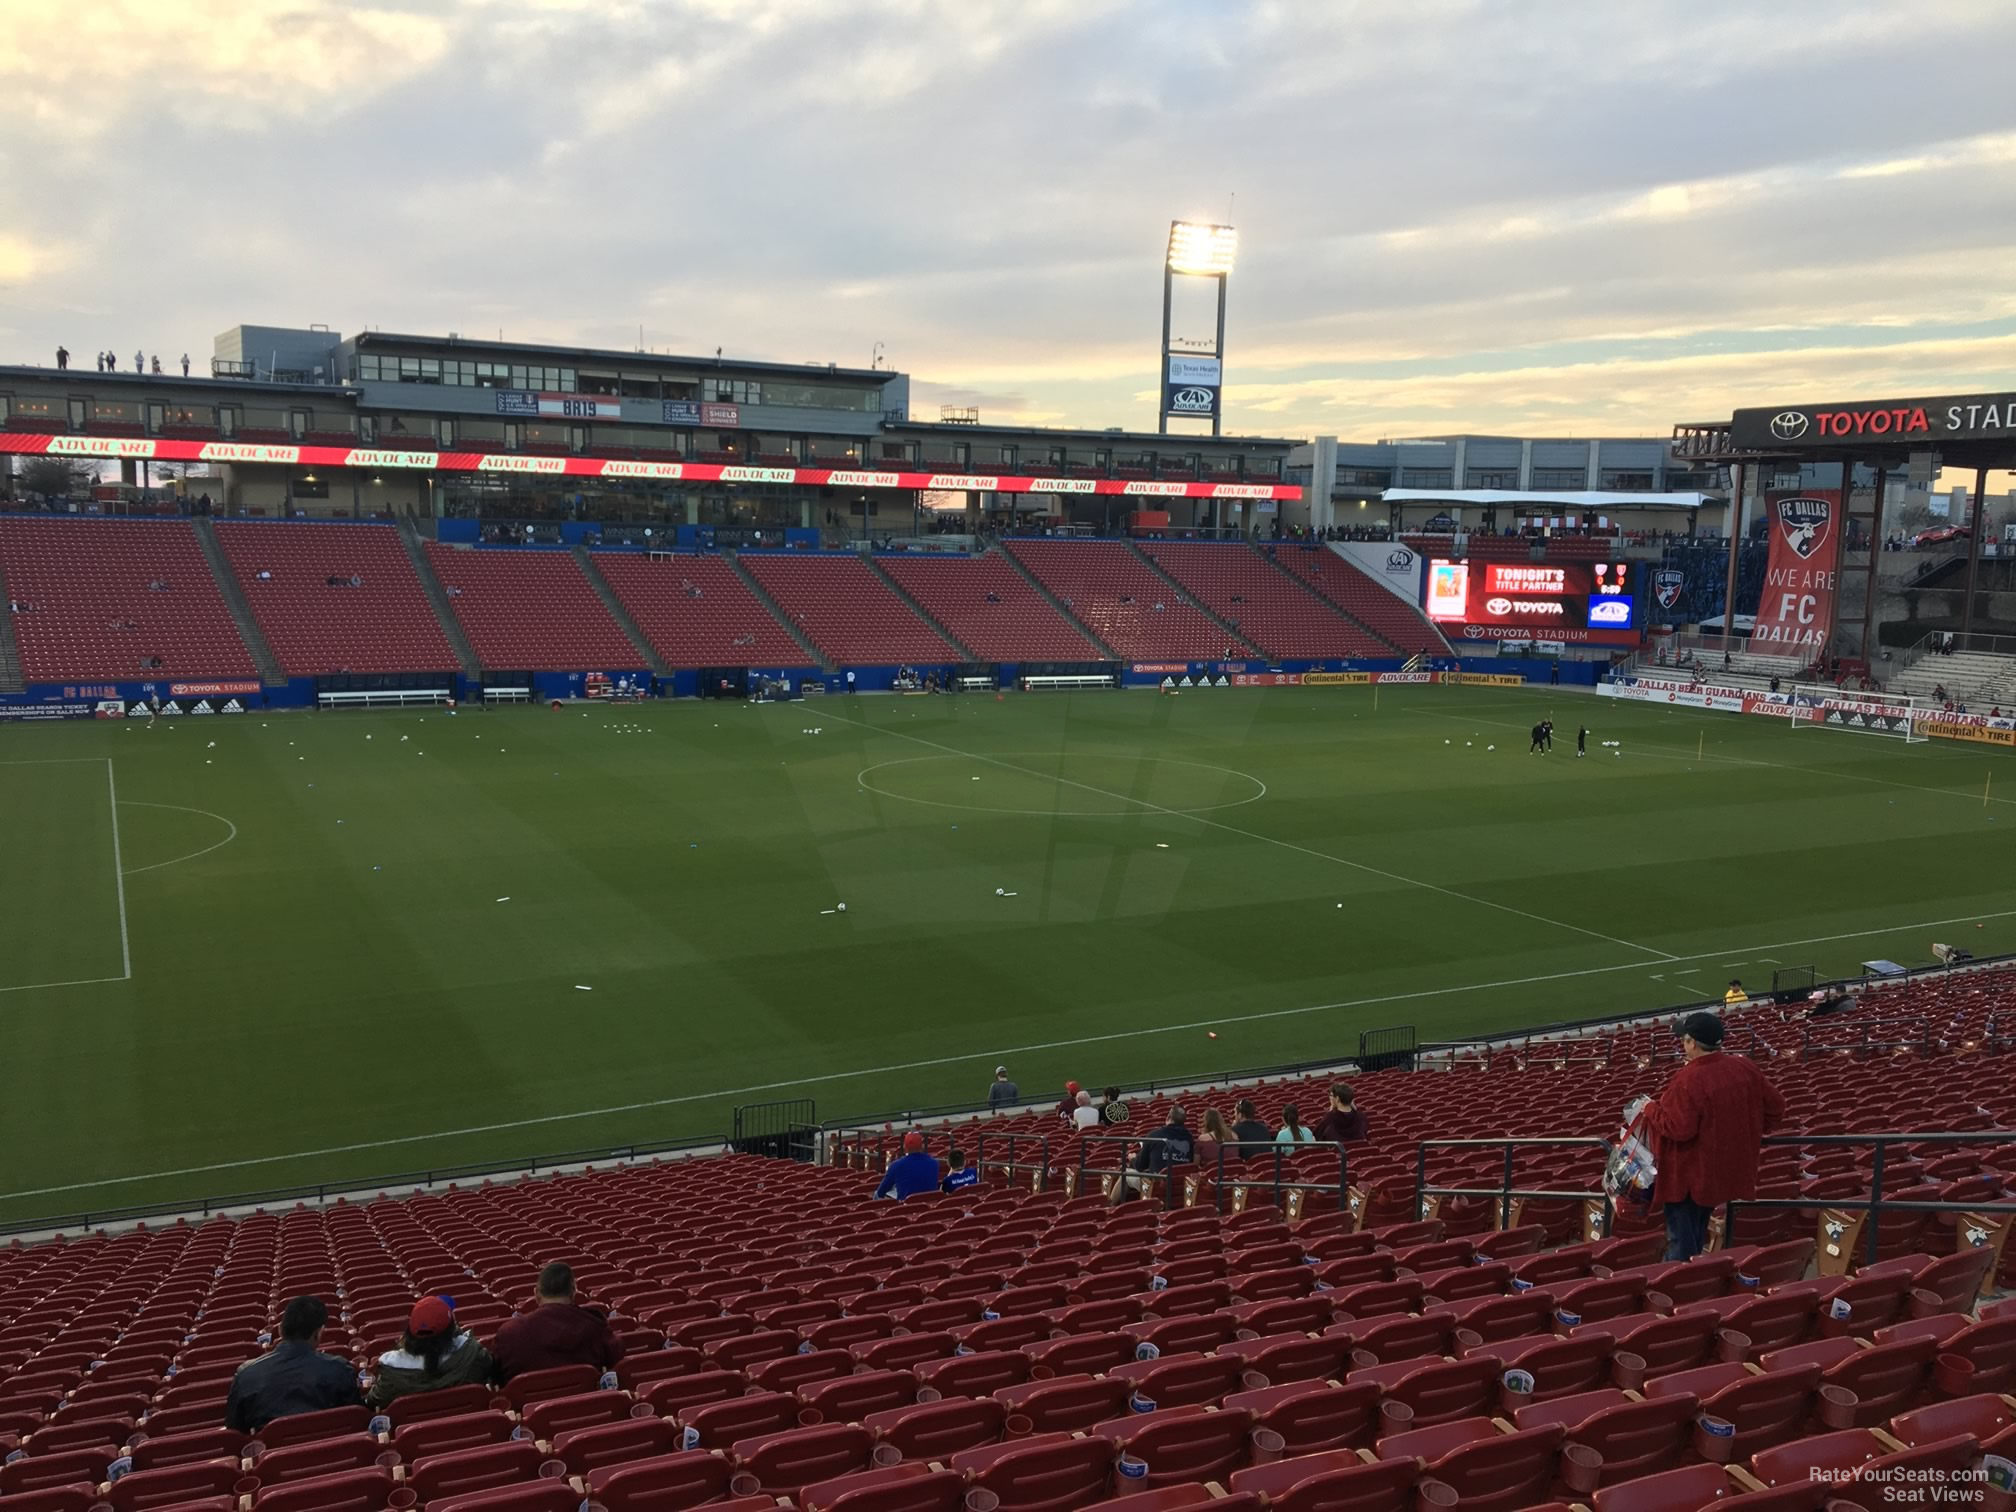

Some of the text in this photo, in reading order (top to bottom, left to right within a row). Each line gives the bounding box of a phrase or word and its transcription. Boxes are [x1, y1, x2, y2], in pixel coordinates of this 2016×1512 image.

[1200, 365, 1218, 373] Health
[563, 400, 597, 417] BR19
[709, 410, 737, 418] SHIELD
[1816, 407, 1930, 436] TOYOTA
[53, 439, 150, 454] ADVOCARE
[203, 447, 294, 460] ADVOCARE
[349, 452, 432, 465] ADVOCARE
[483, 458, 563, 471] ADVOCARE
[603, 463, 682, 477] ADVOCARE
[723, 468, 795, 481] ADVOCARE
[831, 473, 898, 485] ADVOCARE
[931, 477, 997, 488] ADVOCARE
[1033, 480, 1094, 491] ADVOCARE
[1127, 483, 1187, 494] ADVOCARE
[1214, 486, 1273, 497] ADVOCARE
[1781, 502, 1827, 517] FC DALLAS
[604, 528, 644, 537] WINNERS
[717, 530, 753, 540] WINNERS
[1495, 568, 1565, 581] TONIGHT'S
[1657, 573, 1681, 583] FC DALLAS
[1768, 568, 1835, 590] WE ARE
[1495, 581, 1564, 591] TITLE PARTNER
[1513, 601, 1564, 614] TOYOTA
[1779, 593, 1816, 624] FC
[1487, 628, 1588, 640] TOYOTA STADIUM
[1756, 624, 1825, 646] DALLAS
[1303, 674, 1345, 684] Continental
[1379, 673, 1430, 682] ADVOCARE
[189, 683, 259, 692] TOYOTA STADIUM
[1637, 679, 1676, 692] DALLAS
[80, 686, 117, 698] DALLAS
[1623, 687, 1650, 697] TOYOTA
[1677, 694, 1703, 702] MoneyGram
[1713, 699, 1741, 708] MoneyGram
[1824, 699, 1871, 714] DALLAS
[1918, 720, 2012, 741] Continental TIRE
